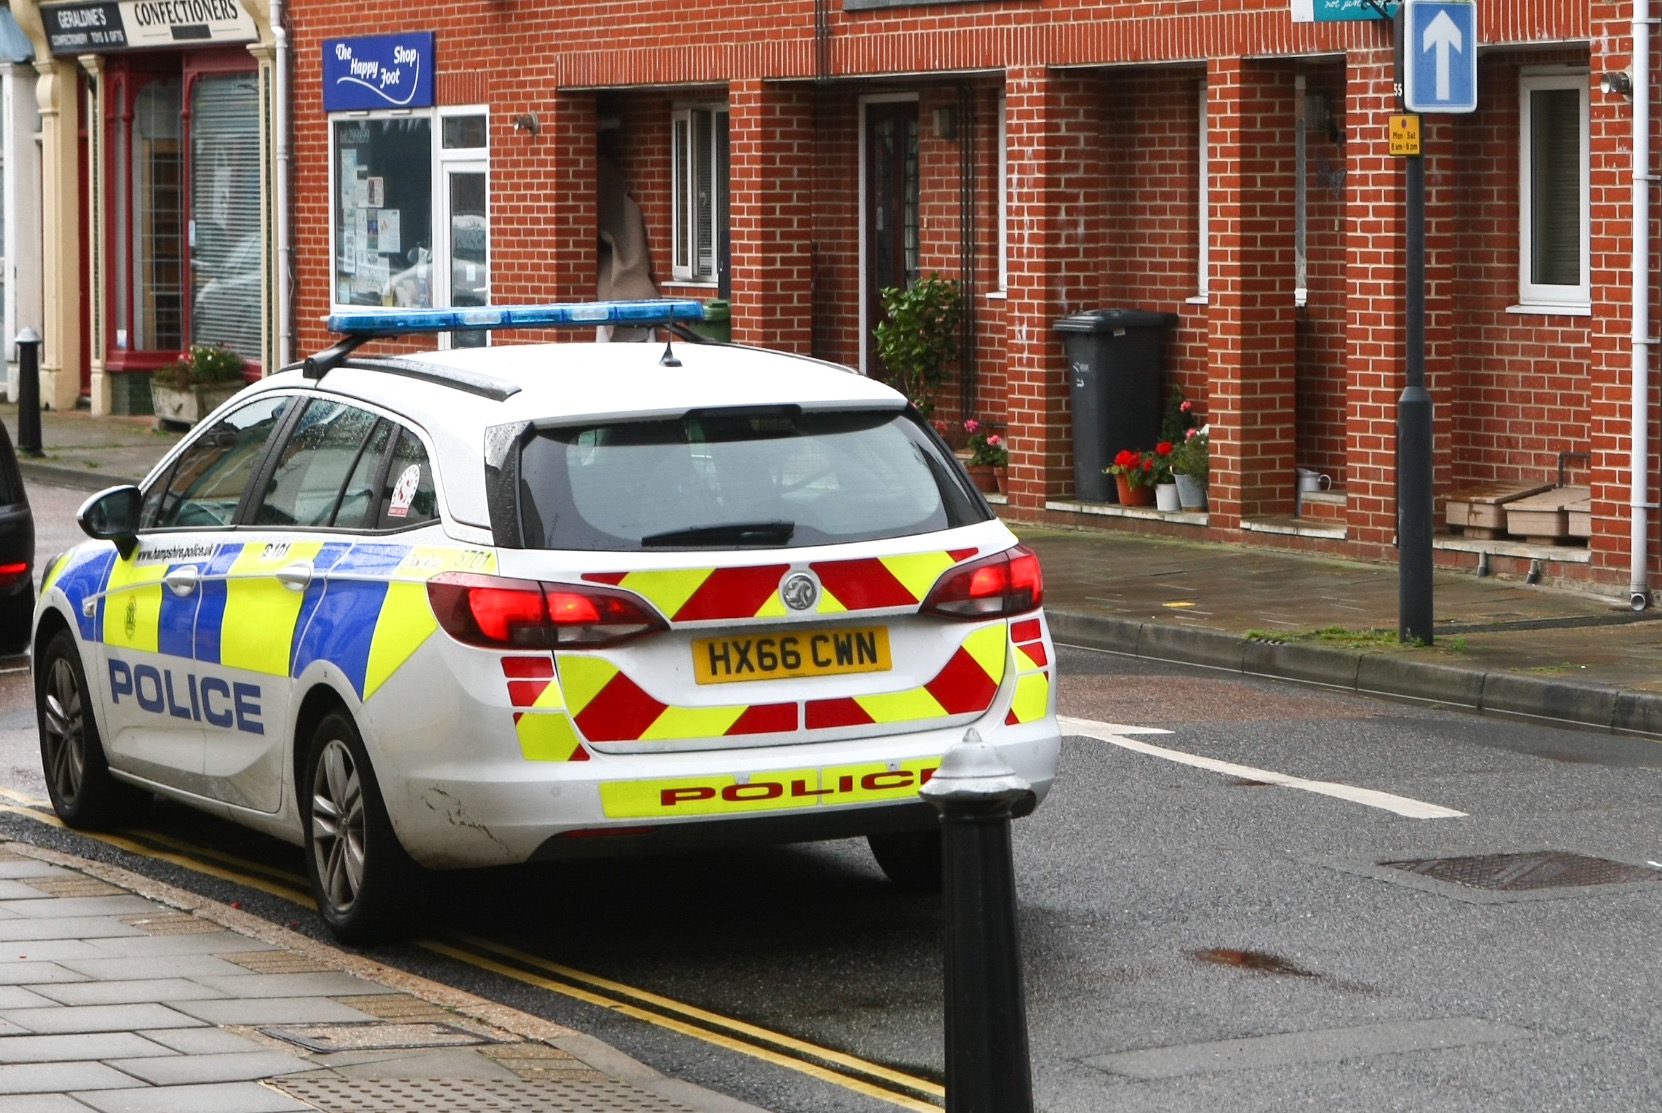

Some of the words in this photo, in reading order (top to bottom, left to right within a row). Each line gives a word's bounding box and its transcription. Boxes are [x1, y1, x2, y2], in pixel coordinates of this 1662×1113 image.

[57, 8, 107, 28] GERALDINE'S
[135, 0, 239, 26] CONFECTIONERS
[335, 43, 352, 60] The
[351, 58, 379, 79] Happy
[380, 67, 401, 89] Foot
[394, 45, 417, 67] Shop
[1392, 132, 1404, 140] Mon
[1407, 131, 1416, 140] Sat
[1409, 144, 1418, 152] pm
[708, 637, 801, 676] HX66
[810, 632, 877, 668] CWN
[108, 658, 264, 735] POLICE
